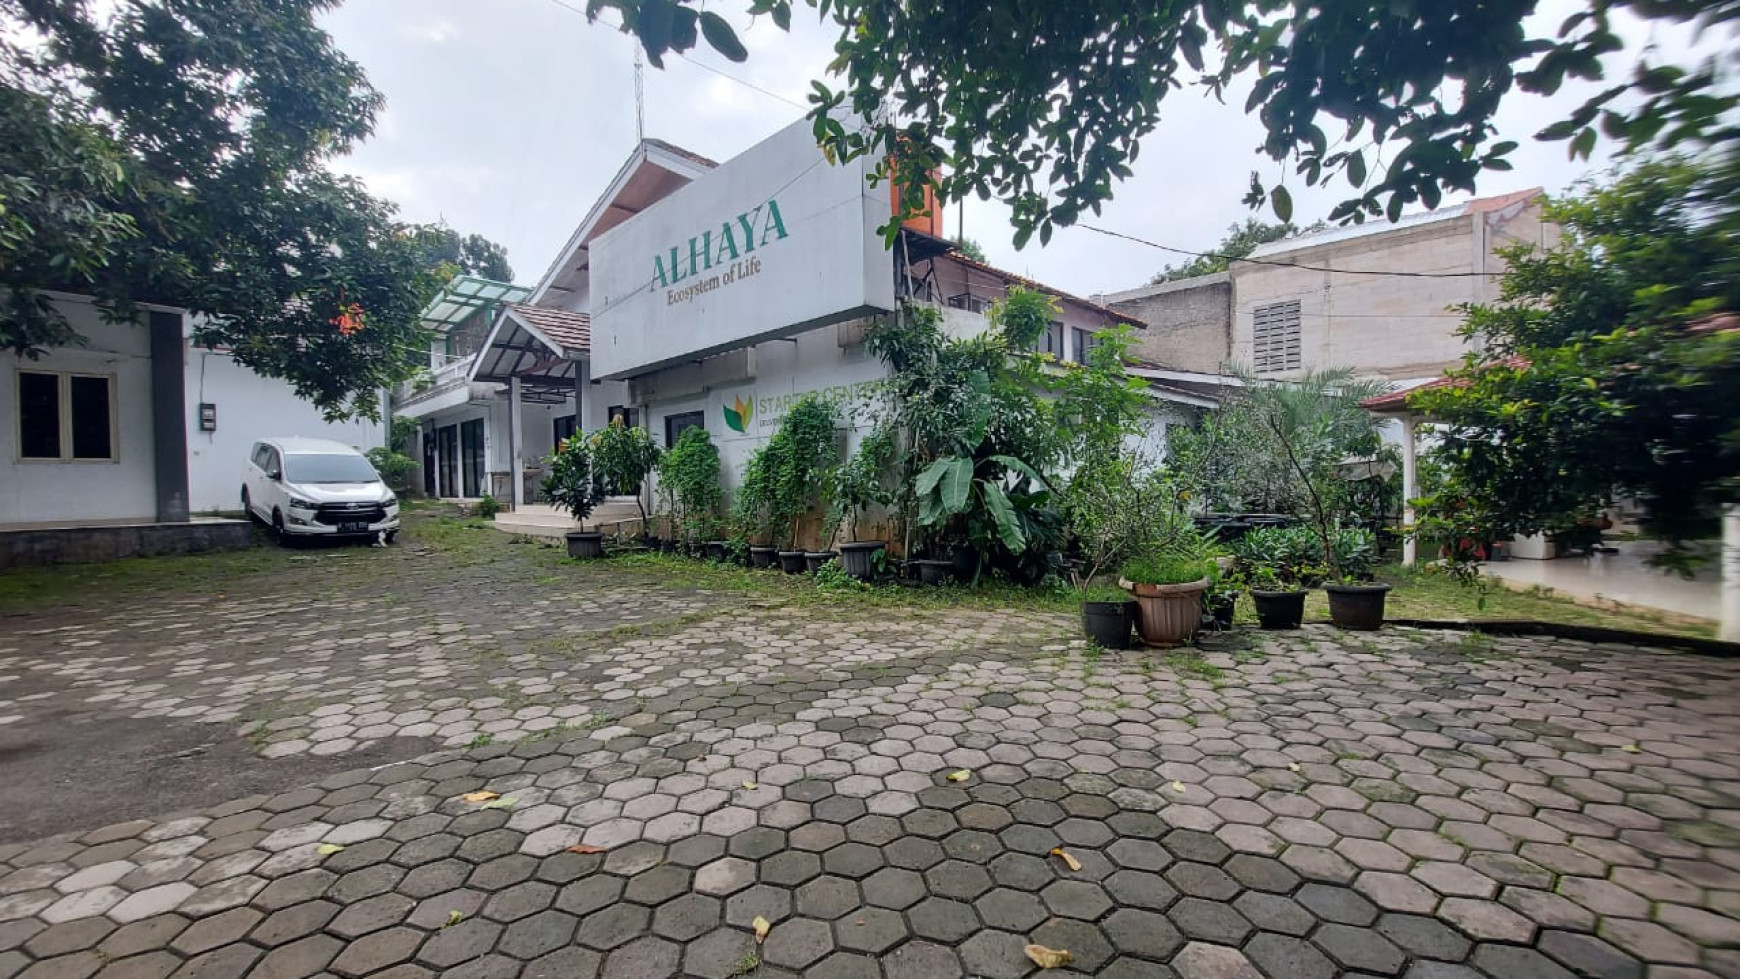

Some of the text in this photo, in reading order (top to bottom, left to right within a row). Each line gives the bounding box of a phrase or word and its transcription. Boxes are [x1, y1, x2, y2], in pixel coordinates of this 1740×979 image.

[649, 199, 789, 293] ALHAYA
[667, 255, 762, 306] Ecosystem of Life
